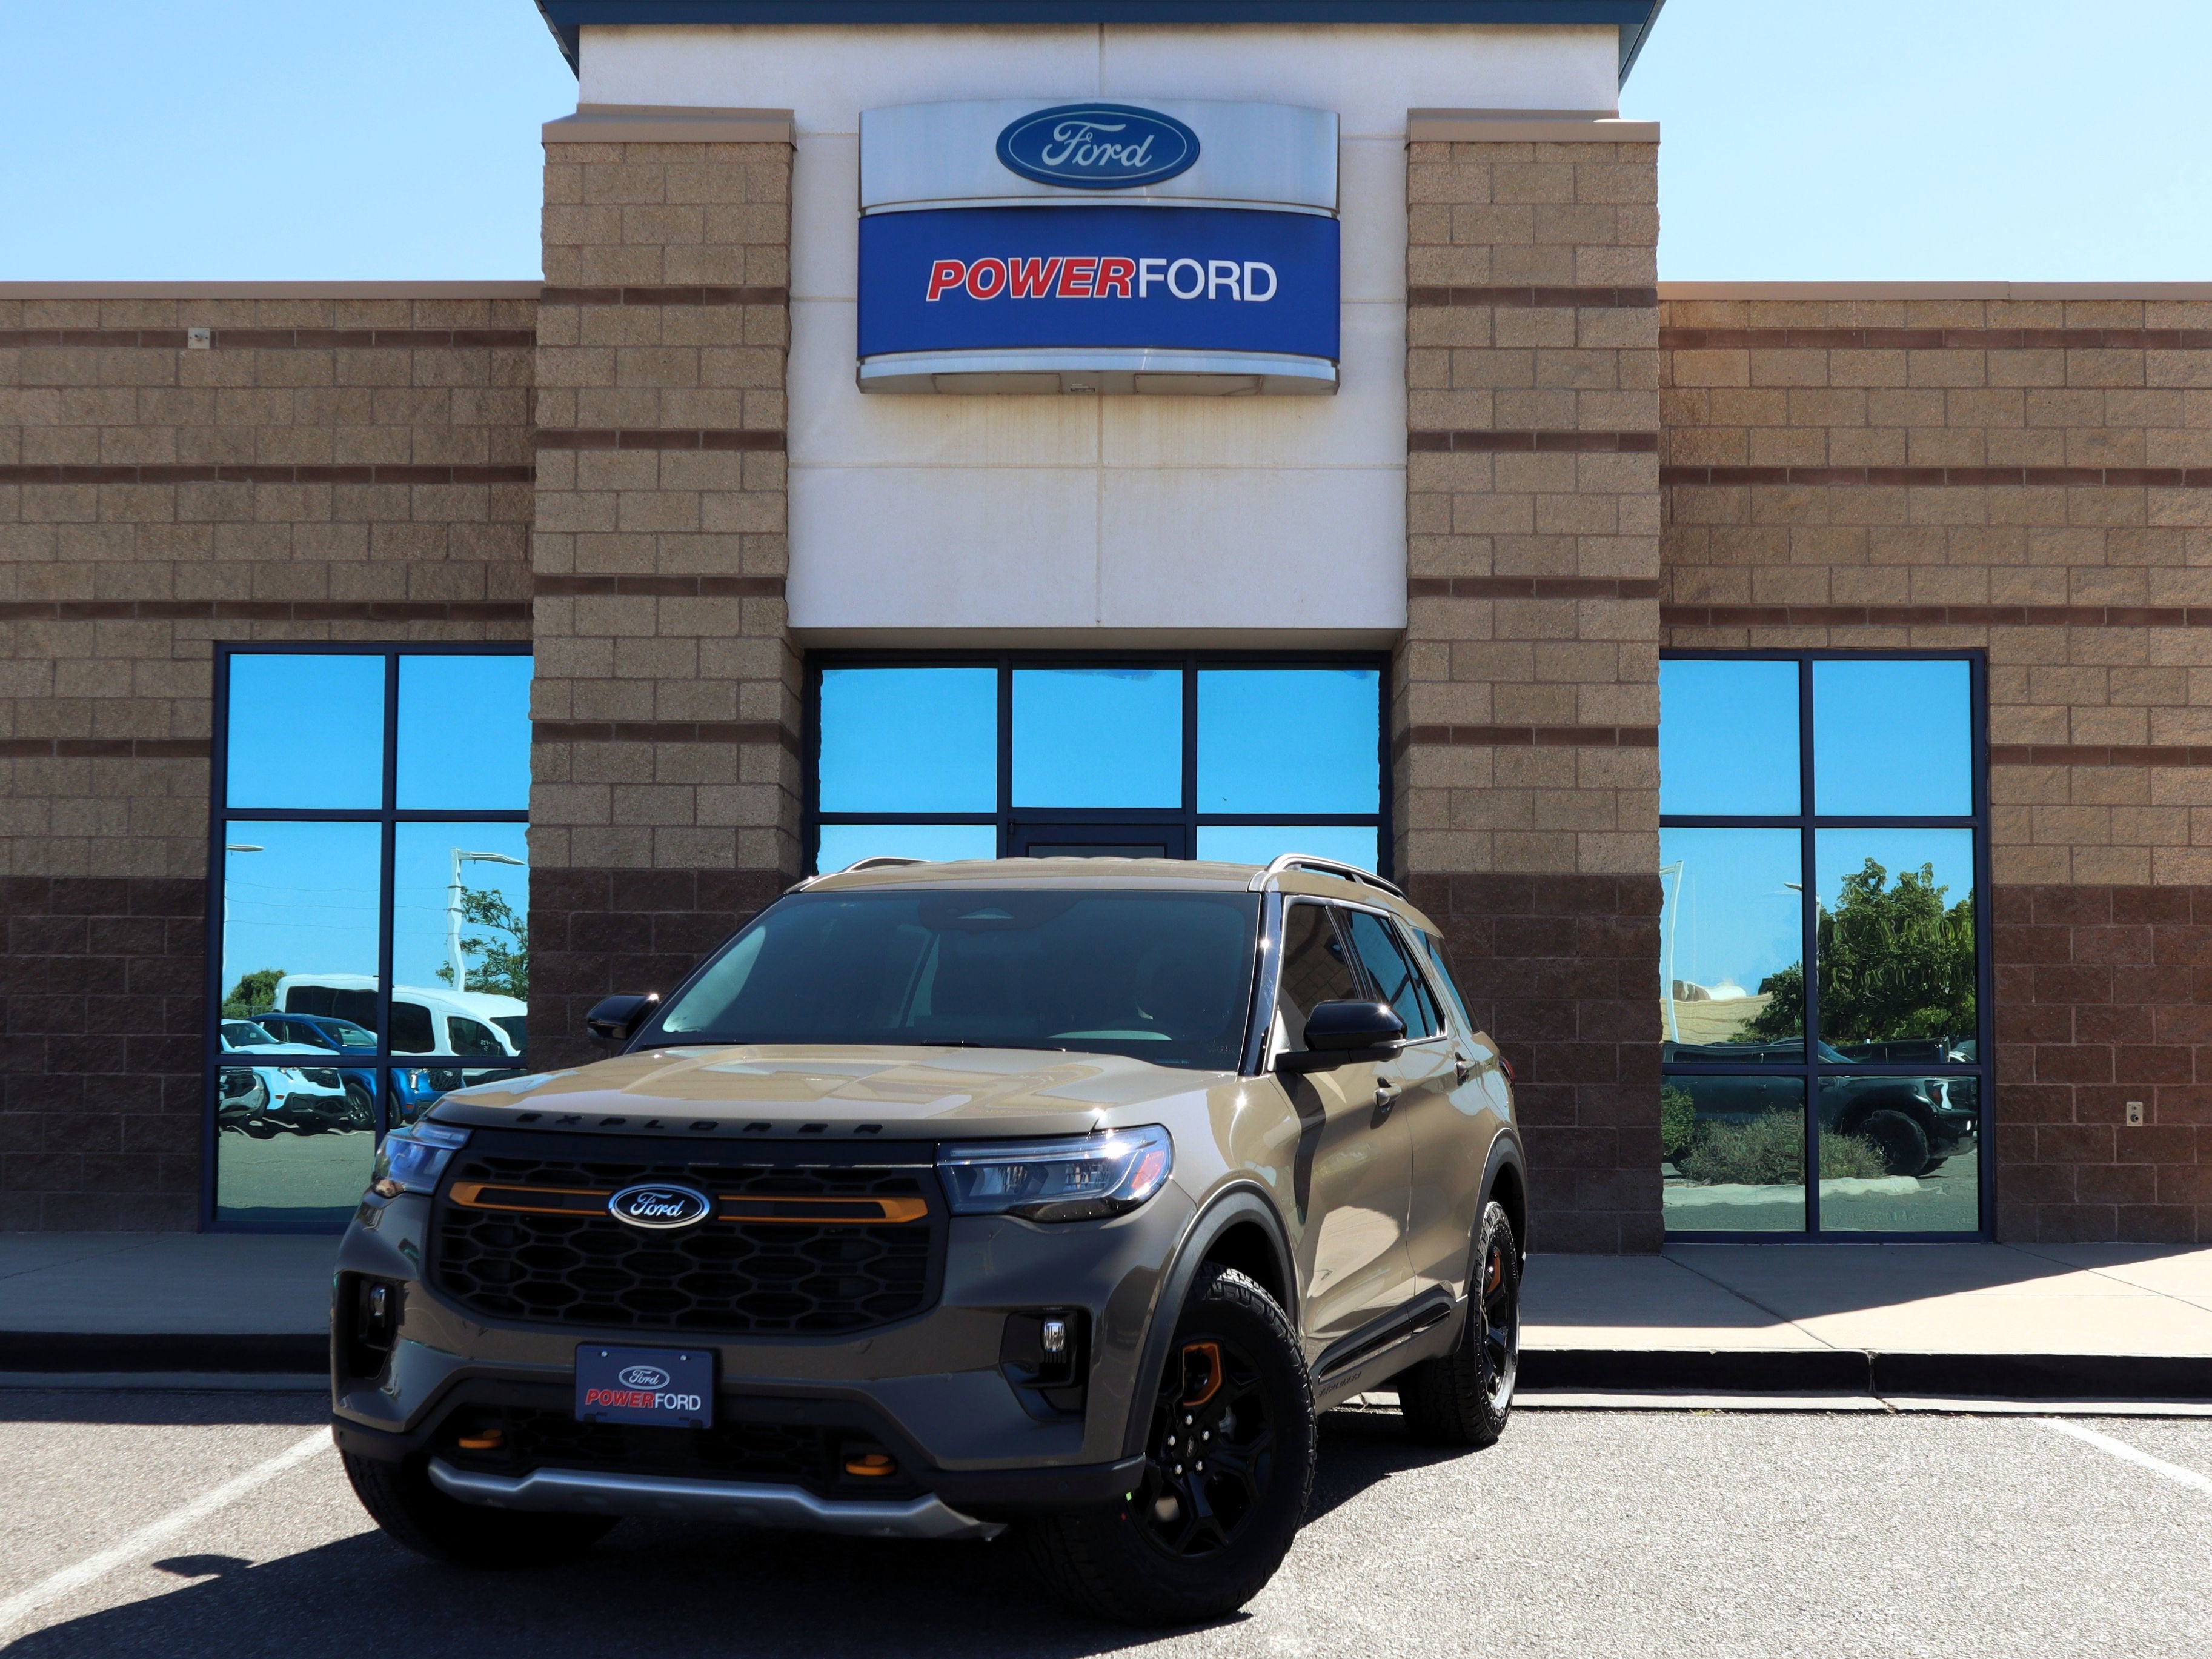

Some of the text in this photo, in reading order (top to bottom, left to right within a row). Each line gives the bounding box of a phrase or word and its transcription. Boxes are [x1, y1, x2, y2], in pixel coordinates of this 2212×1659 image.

[1041, 121, 1155, 167] Ford
[926, 256, 1278, 302] POWERFORD
[516, 1113, 884, 1134] EXPLORER
[630, 1192, 685, 1217] Ford
[629, 1370, 659, 1385] Ford
[585, 1389, 701, 1411] POWERFORD
